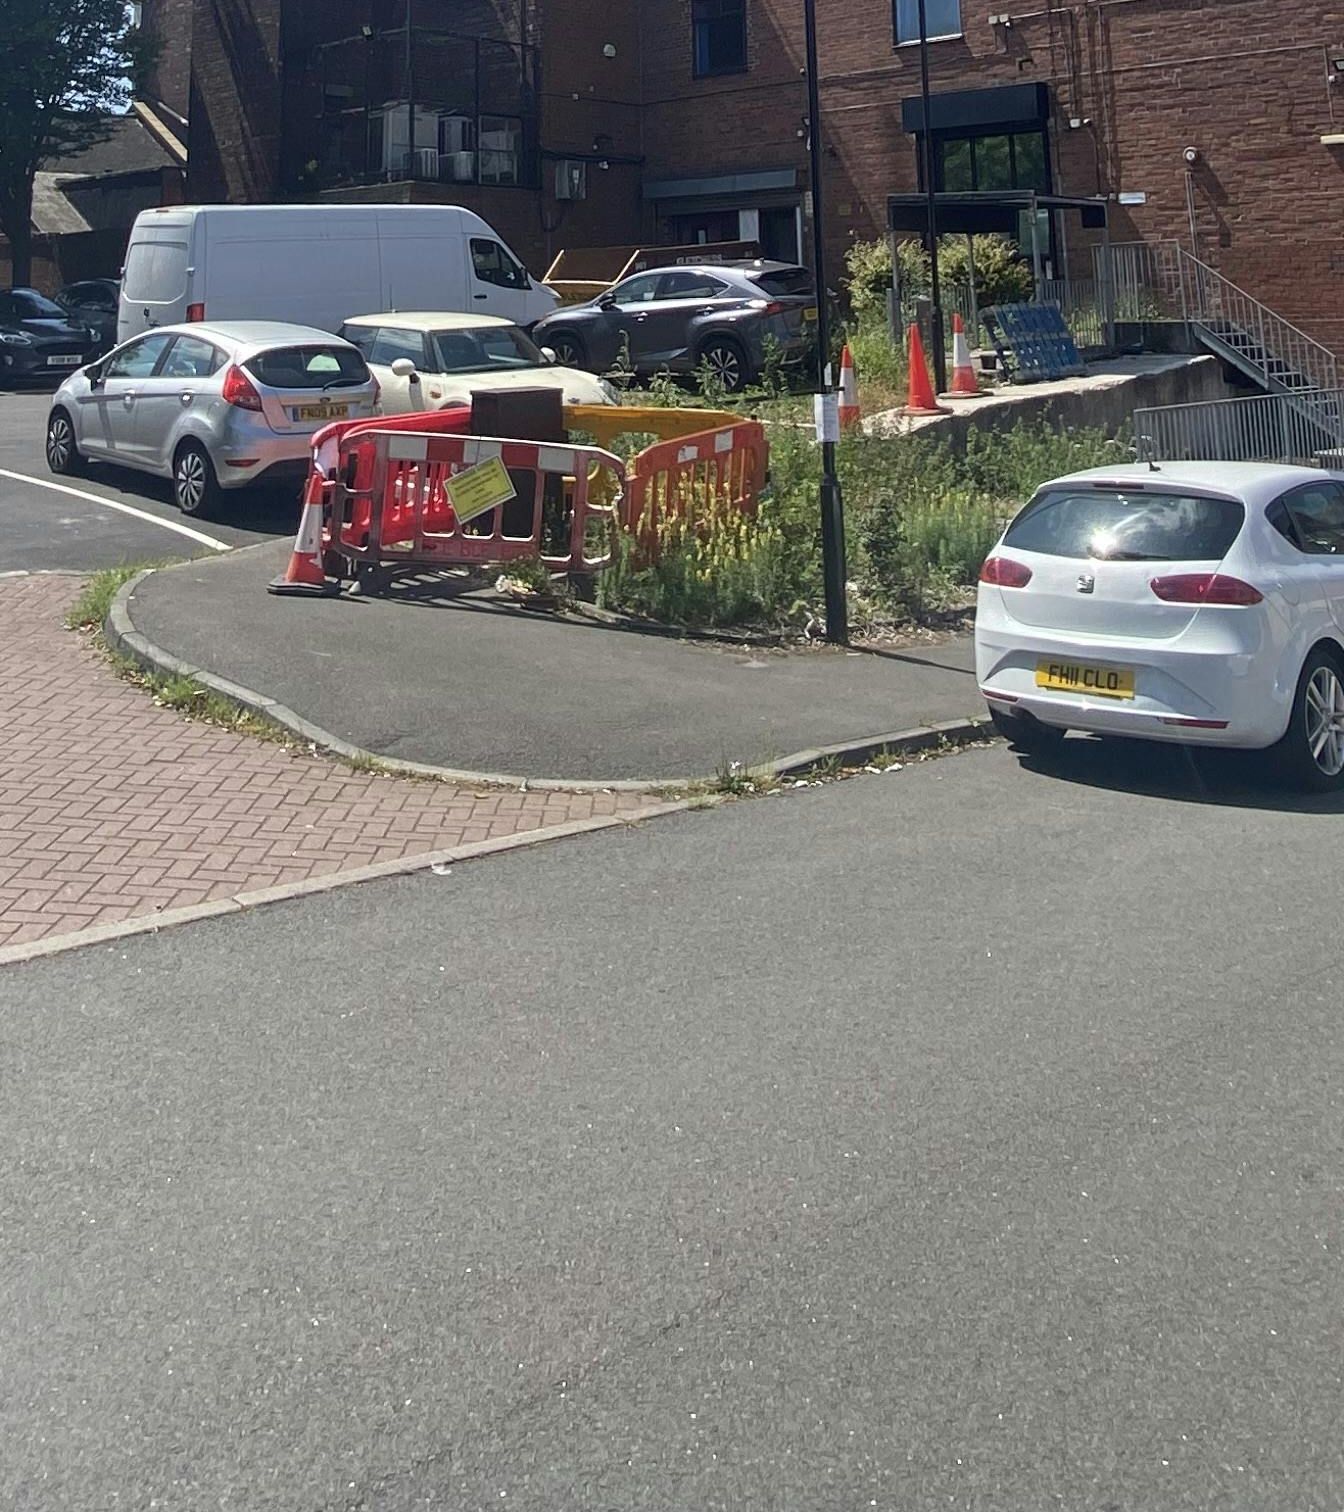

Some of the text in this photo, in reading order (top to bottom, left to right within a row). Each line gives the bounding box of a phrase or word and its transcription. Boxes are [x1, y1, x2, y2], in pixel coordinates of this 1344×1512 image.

[329, 404, 348, 417] AXP
[1048, 664, 1118, 690] FH11 CLO
